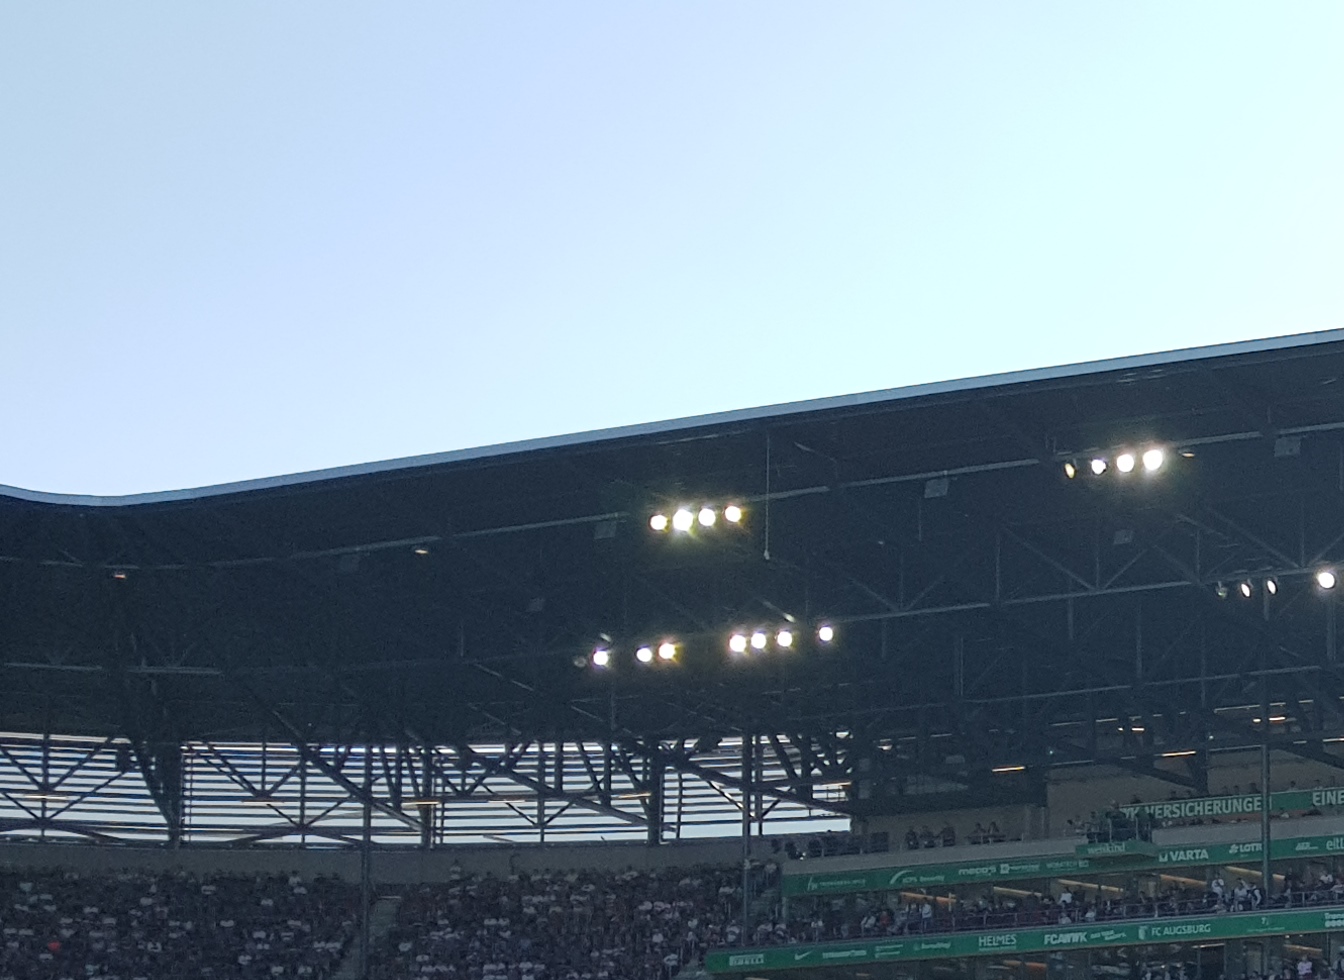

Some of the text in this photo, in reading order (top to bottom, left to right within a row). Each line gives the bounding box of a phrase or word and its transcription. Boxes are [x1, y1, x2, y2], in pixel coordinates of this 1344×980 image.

[1169, 848, 1209, 862] VARTA
[1151, 922, 1212, 936] FC AUGSBURG
[978, 933, 1018, 948] HELMES
